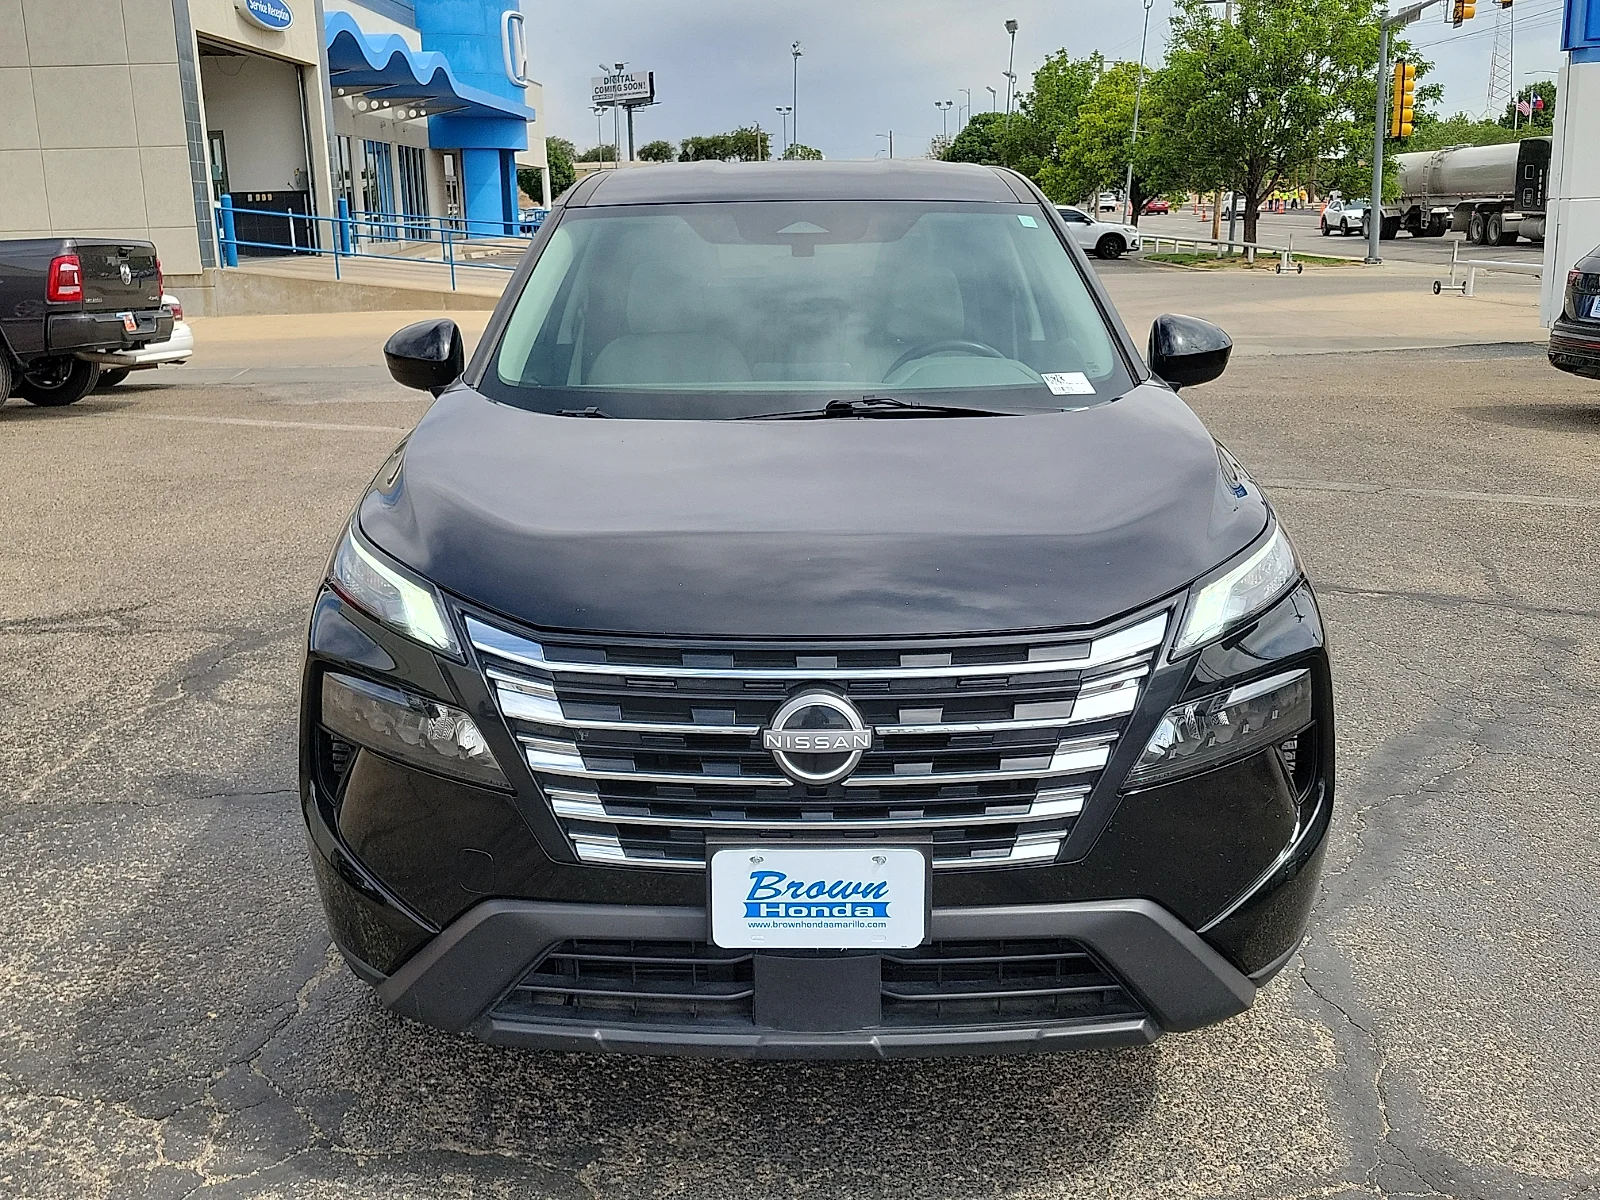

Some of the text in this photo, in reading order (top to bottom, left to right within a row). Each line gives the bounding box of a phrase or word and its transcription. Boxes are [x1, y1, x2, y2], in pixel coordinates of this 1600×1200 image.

[249, 0, 290, 21] Service Reception
[603, 74, 635, 85] DIGITAL
[594, 85, 622, 94] COMING
[623, 82, 646, 91] SOON!
[766, 735, 869, 749] NISSAN
[746, 871, 889, 901] Brown
[760, 903, 874, 917] Honda
[748, 920, 886, 929] www.brownhondaamarillo.com
